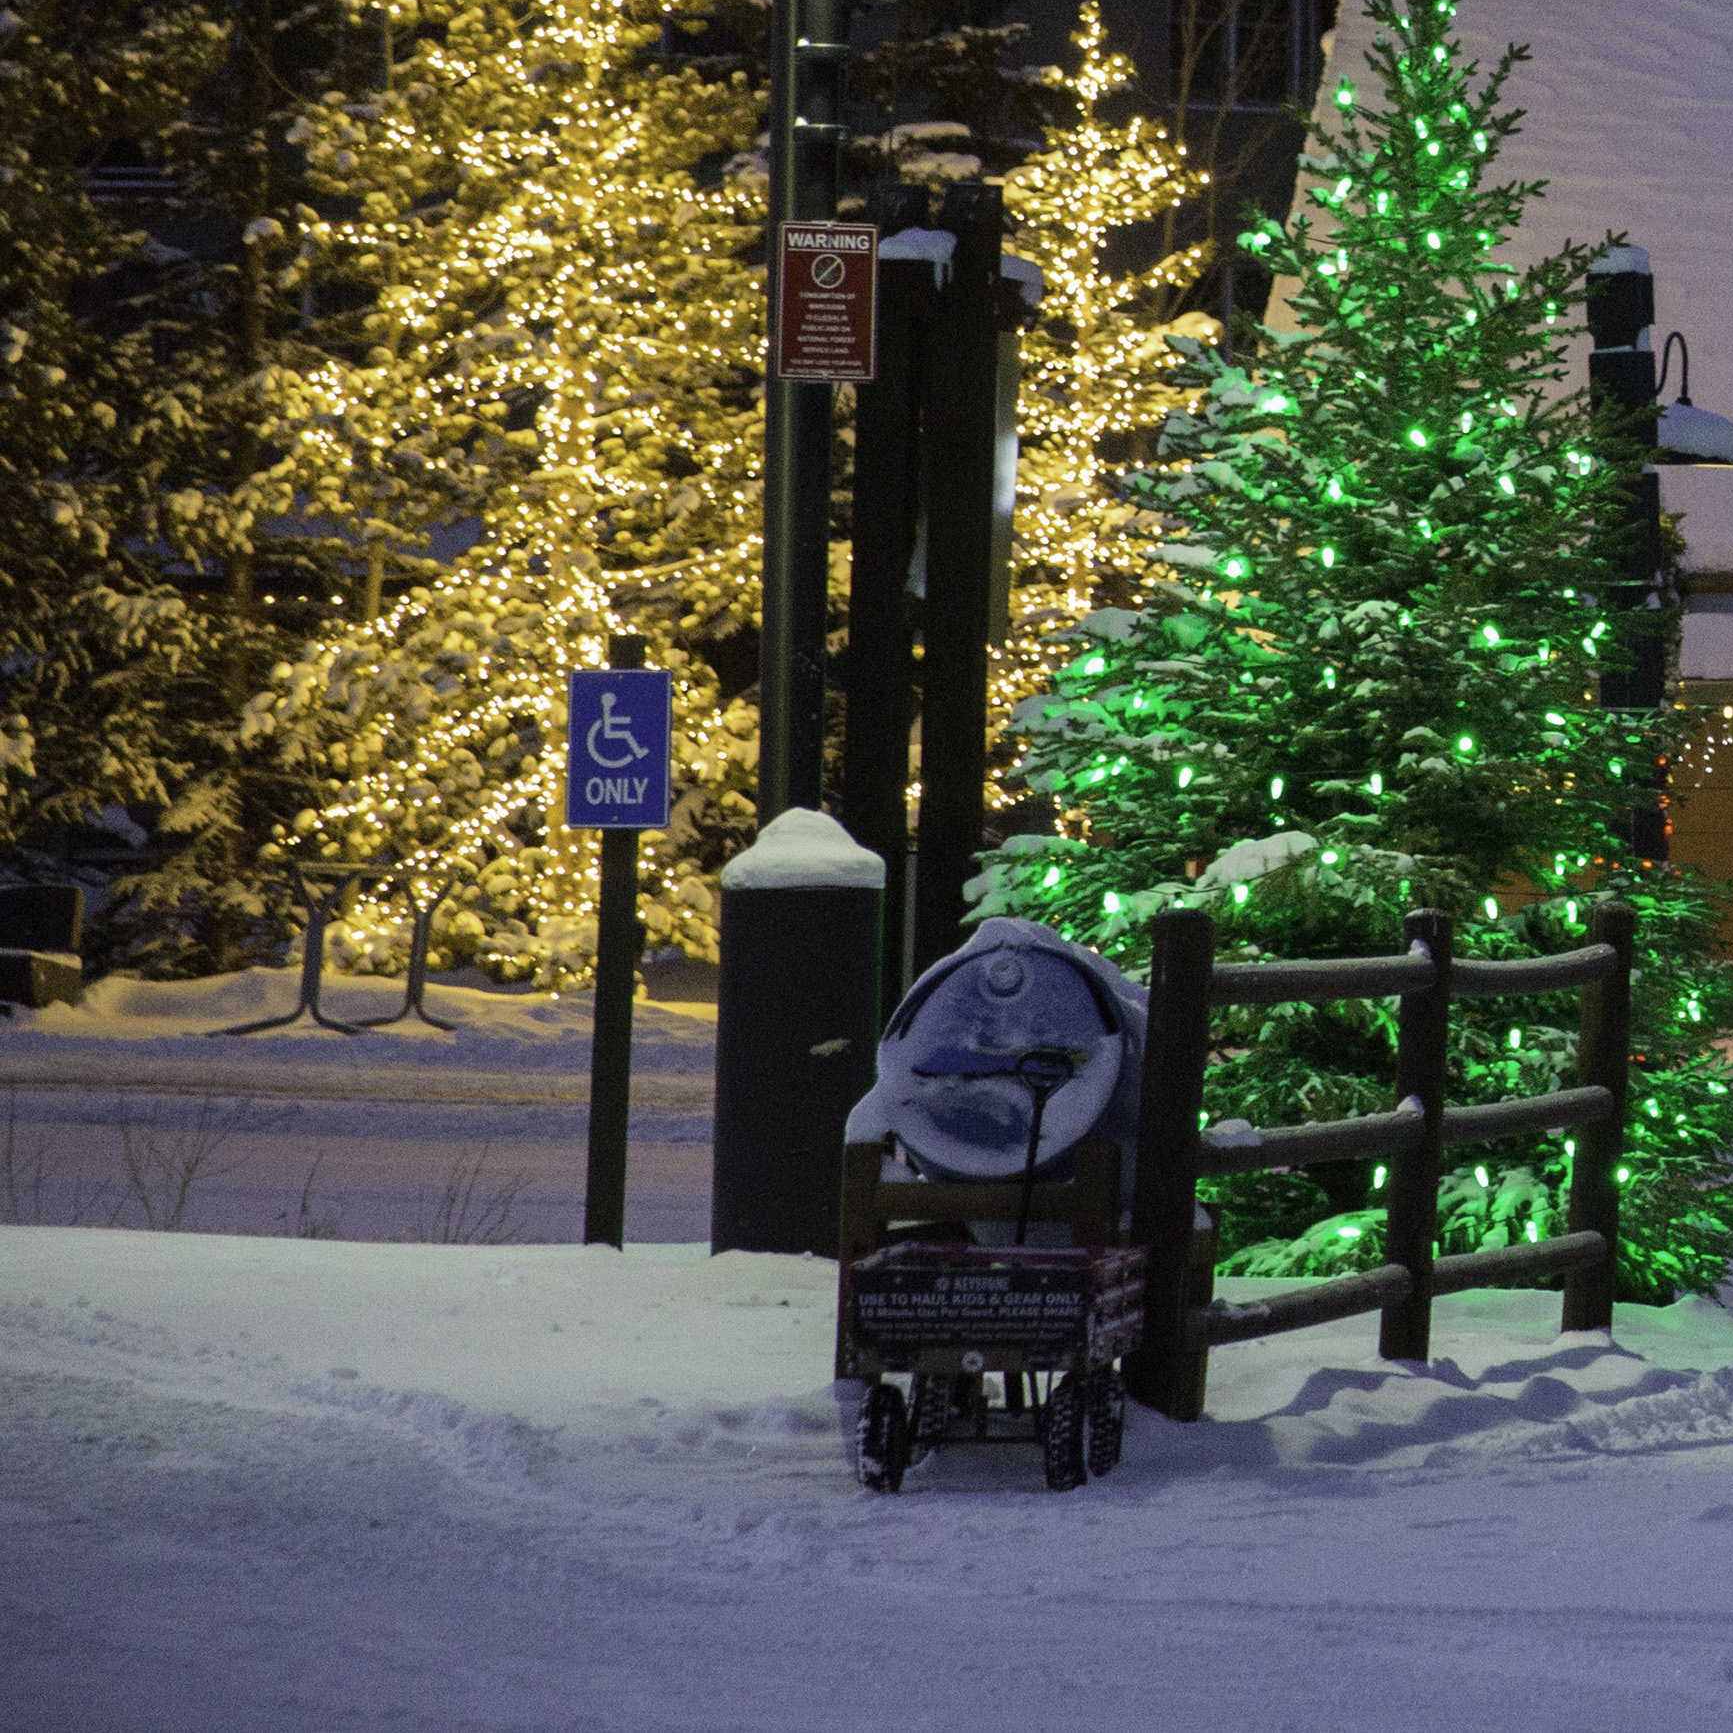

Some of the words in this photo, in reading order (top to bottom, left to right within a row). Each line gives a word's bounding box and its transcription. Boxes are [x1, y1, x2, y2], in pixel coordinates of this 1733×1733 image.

[787, 232, 871, 250] WARNING
[585, 777, 649, 805] ONLY
[953, 1275, 1011, 1292] KEYSTONE
[858, 1293, 886, 1306] USE
[890, 1293, 908, 1306] TO
[911, 1293, 948, 1306] HAUL
[952, 1293, 986, 1306] KIDS
[988, 1293, 1001, 1306] &
[1004, 1293, 1043, 1306] GEAR
[998, 1307, 1041, 1319] PLEASE
